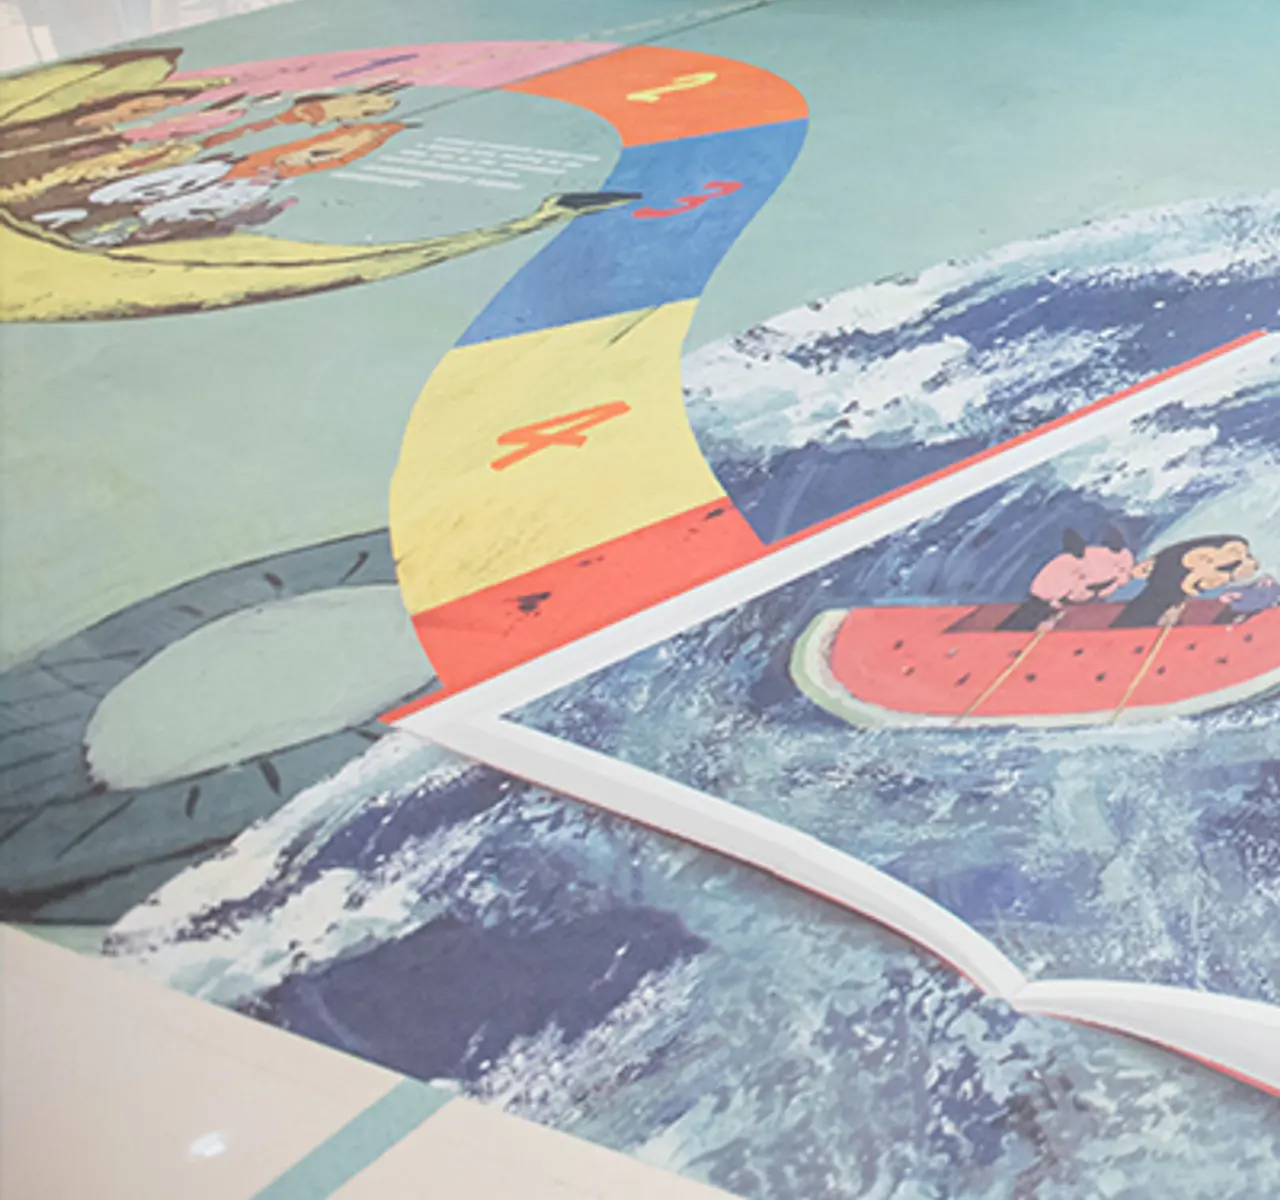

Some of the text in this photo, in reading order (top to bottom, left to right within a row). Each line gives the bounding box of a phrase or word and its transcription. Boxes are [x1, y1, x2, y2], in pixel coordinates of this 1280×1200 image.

[626, 71, 717, 104] 2
[632, 181, 743, 219] 3
[490, 400, 631, 471] 4
